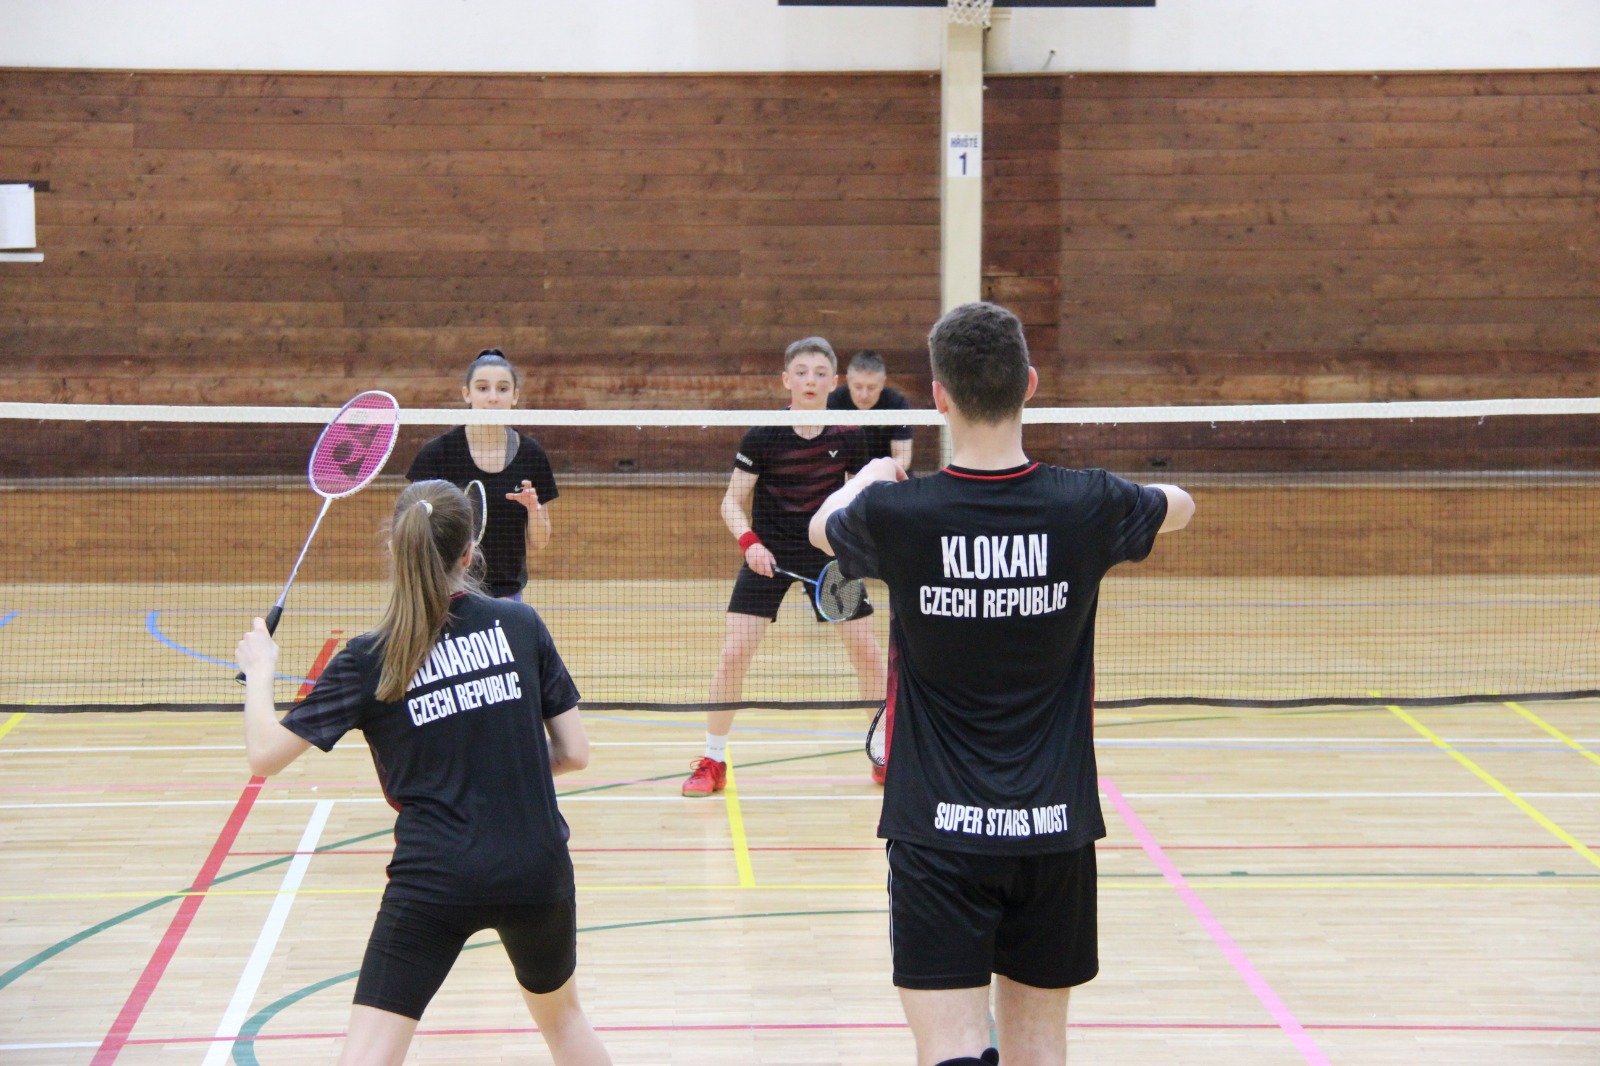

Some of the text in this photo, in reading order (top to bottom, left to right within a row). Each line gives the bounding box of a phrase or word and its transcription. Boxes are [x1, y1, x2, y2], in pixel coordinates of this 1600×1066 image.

[959, 152, 967, 176] 1
[941, 533, 1048, 580] KLOKAN
[919, 581, 1069, 619] CZECH REPUBLIC
[407, 671, 522, 727] CZECH REPUBLIC
[934, 802, 1068, 837] SUPER STARS MOST
